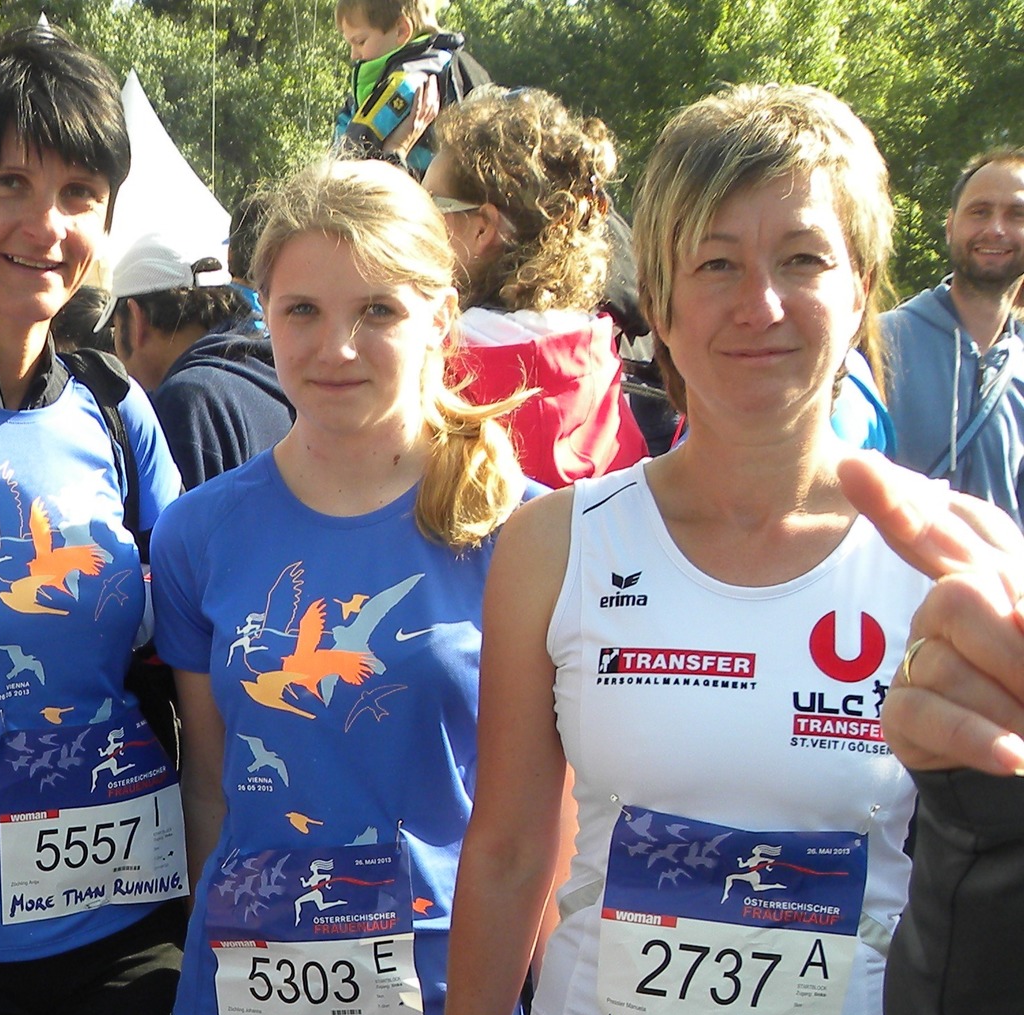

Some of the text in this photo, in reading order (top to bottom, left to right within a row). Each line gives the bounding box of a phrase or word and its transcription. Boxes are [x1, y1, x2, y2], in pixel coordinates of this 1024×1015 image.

[600, 591, 648, 608] erima
[622, 651, 750, 674] TRANSFER
[6, 682, 30, 690] VIENNA
[597, 677, 757, 690] PERSONALMANAGEMENT
[793, 692, 864, 716] ULC
[108, 765, 167, 789] ÖSTERREICHISCHER
[11, 810, 47, 822] woman
[36, 816, 141, 873] 5557
[10, 893, 55, 918] MORE
[62, 884, 105, 907] THAN
[743, 897, 841, 915] ÖSTERREICHISCHER
[313, 912, 396, 925] ÖSTERREICHISCHER
[616, 911, 662, 926] woman
[742, 906, 840, 925] FRAUENLAUF
[314, 919, 397, 935] FRAUENLAUF
[220, 940, 257, 949] woman
[373, 940, 397, 974] E
[799, 939, 829, 980] A
[248, 956, 360, 1004] 5303
[635, 939, 782, 1008] 2737
